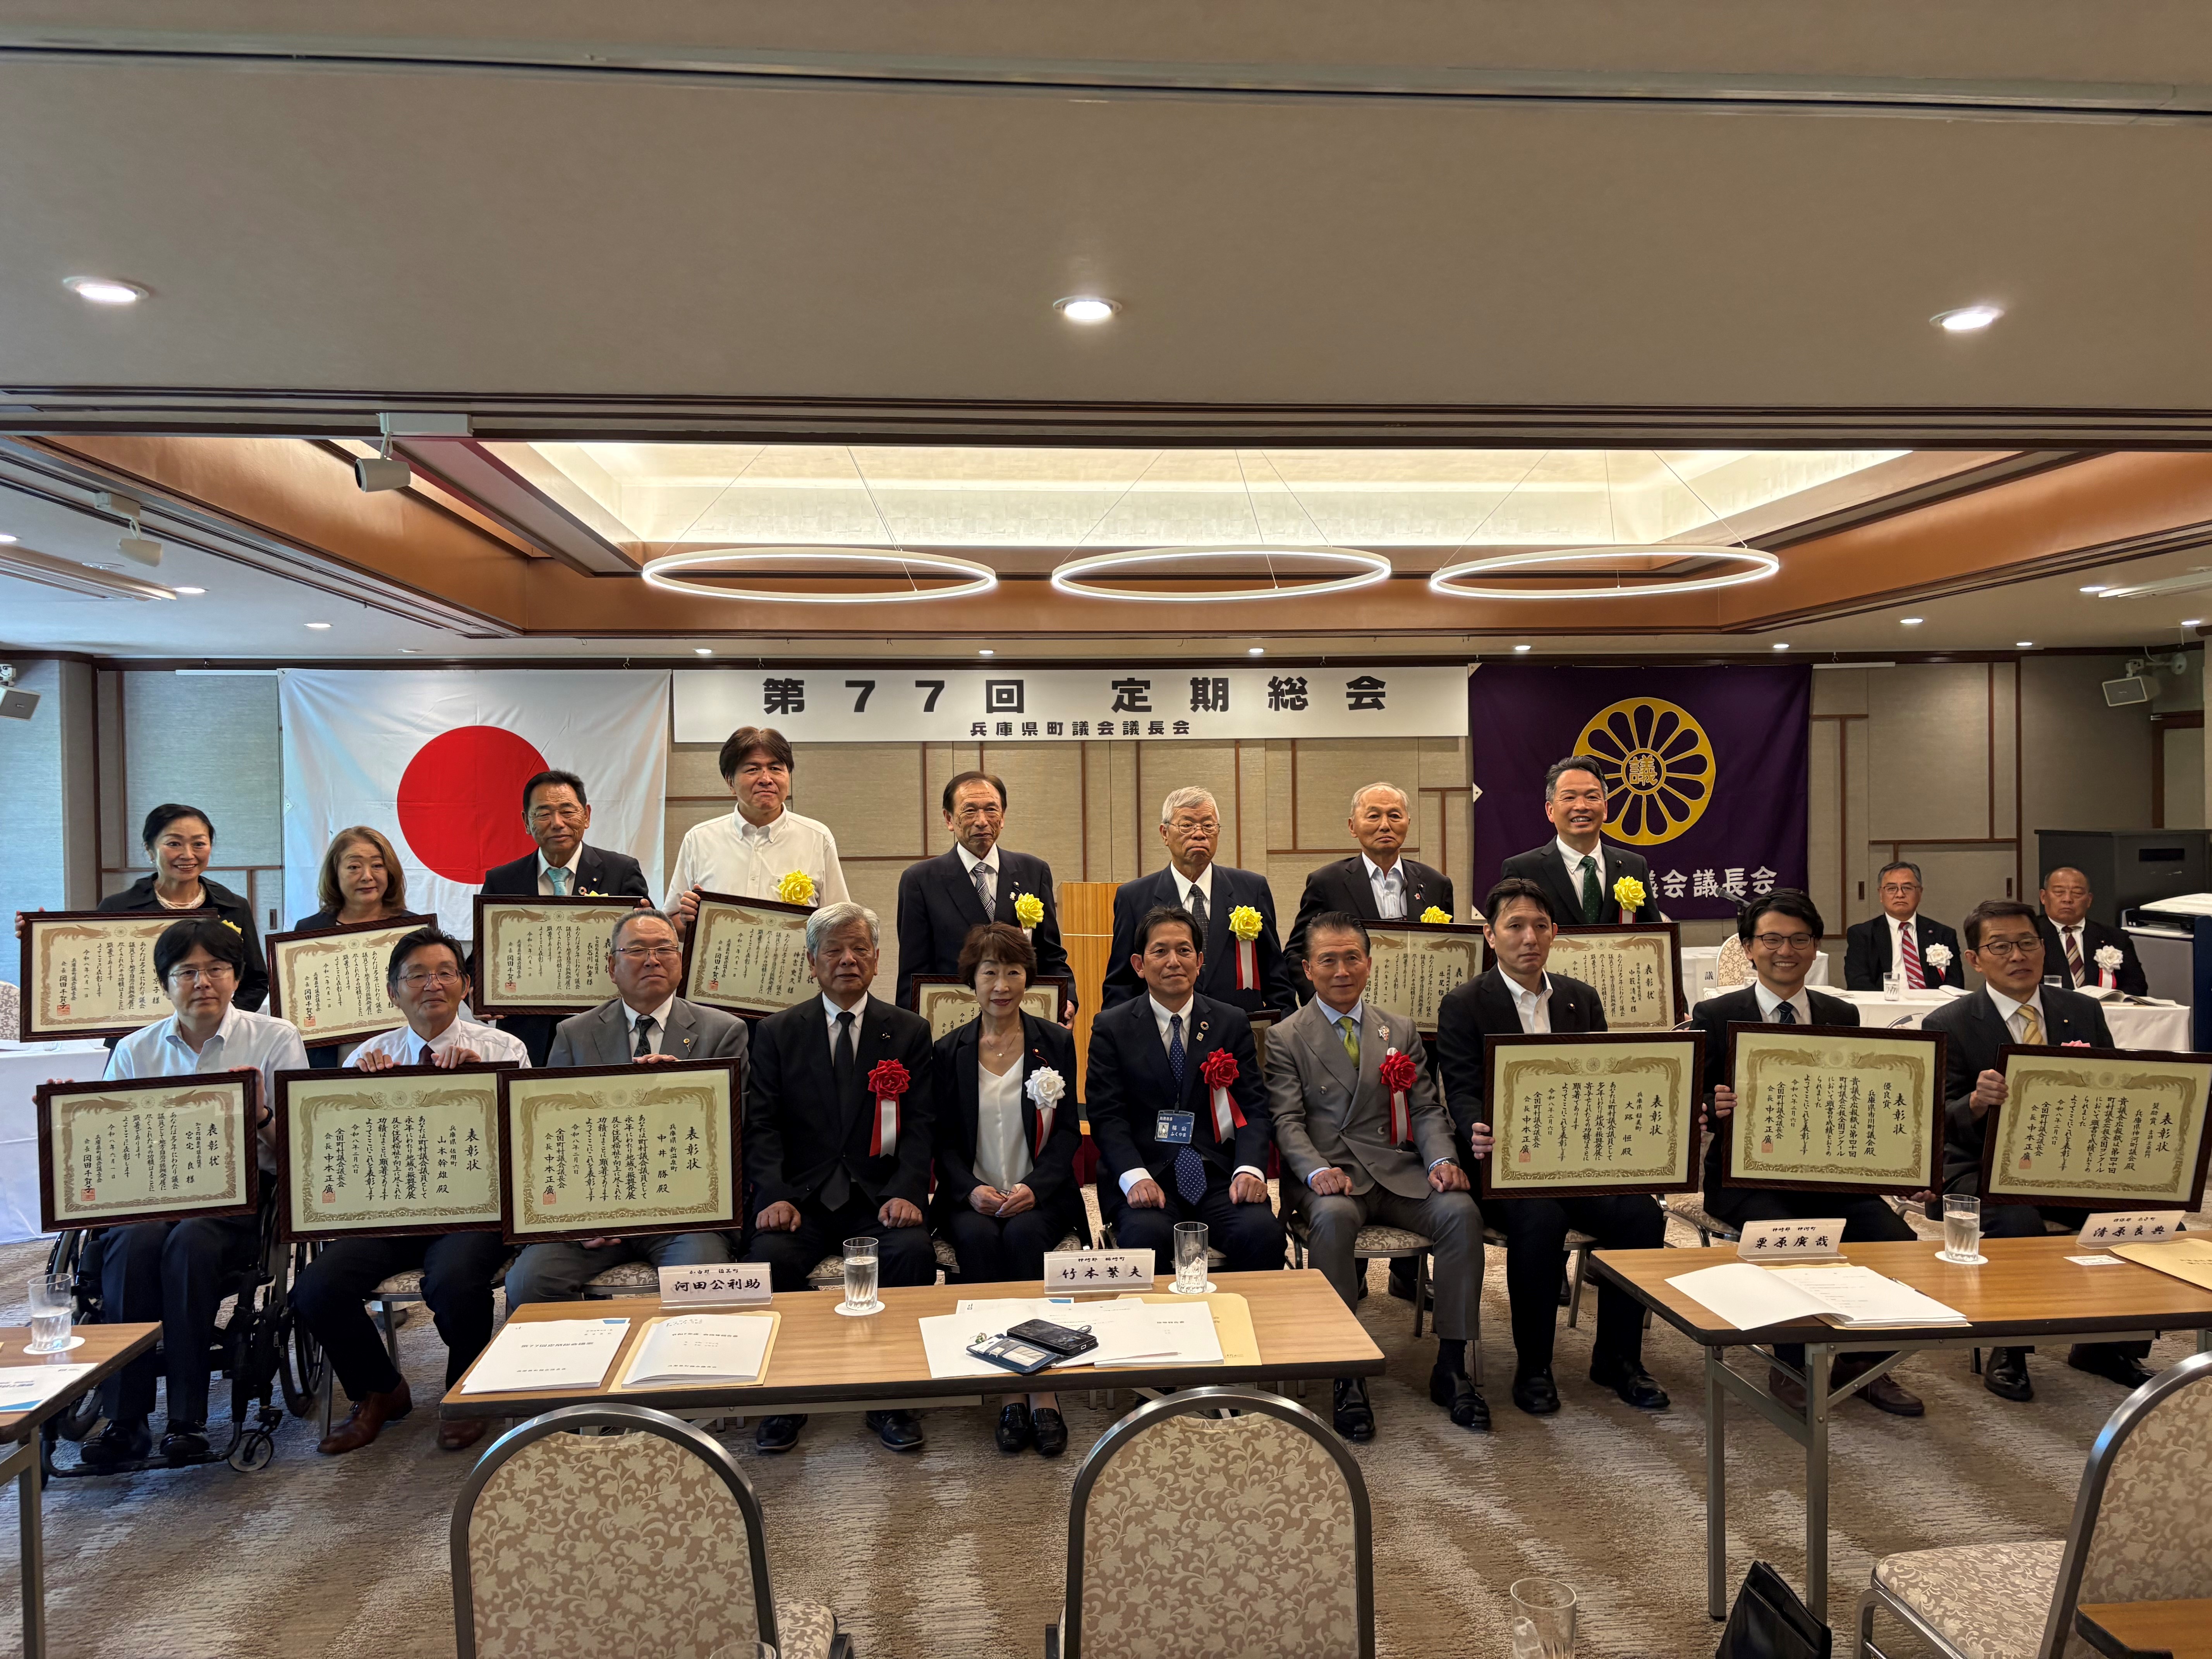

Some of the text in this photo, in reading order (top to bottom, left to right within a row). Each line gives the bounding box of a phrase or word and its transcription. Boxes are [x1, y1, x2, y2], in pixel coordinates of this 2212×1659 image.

[761, 674, 1388, 716] 第77回 定期総会
[969, 720, 1192, 737] 兵庫県町議会議長会
[1629, 755, 1658, 787] 議
[1644, 964, 1654, 1000] 表彰状
[1523, 1096, 1531, 1112] 会長
[1767, 1085, 1774, 1103] 会長
[1814, 1076, 1822, 1108] られました
[1649, 1095, 1663, 1136] 表彰状
[1891, 1093, 1907, 1135] 表彰状
[2028, 1104, 2039, 1121] 会長
[84, 1138, 90, 1152] 会長
[205, 1122, 220, 1167] 表彰状
[324, 1133, 332, 1150] 会長
[544, 1133, 553, 1151] 会長
[2155, 1112, 2174, 1152] 表彰状
[108, 1123, 116, 1179] 令和八年六月一日
[449, 1147, 457, 1167] 佐用町
[464, 1128, 481, 1171] 表彰状
[684, 1127, 702, 1170] 表彰状
[2094, 1225, 2165, 1237] 清原良典
[675, 1278, 761, 1292] 河田公利助
[1062, 1266, 1142, 1279] 竹本繁夫
